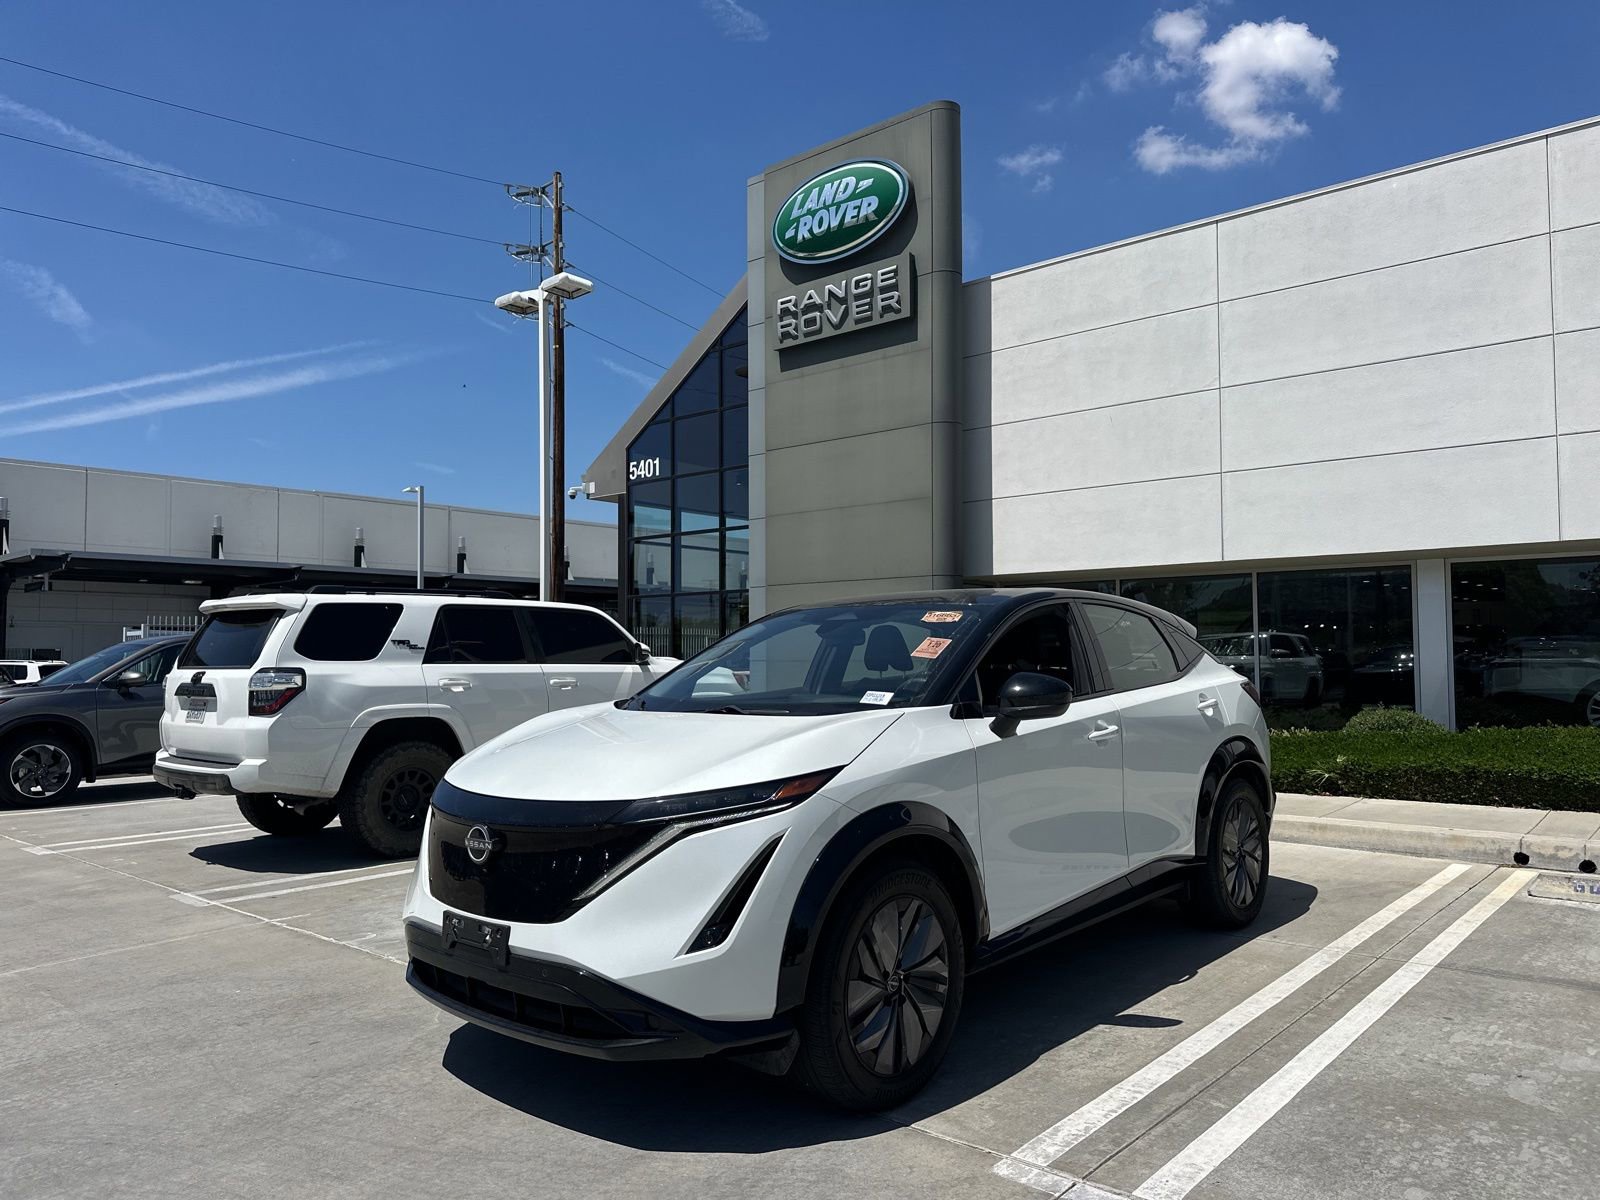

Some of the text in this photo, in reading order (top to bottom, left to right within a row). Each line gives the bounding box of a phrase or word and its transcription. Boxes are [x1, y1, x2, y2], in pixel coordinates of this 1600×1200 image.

[796, 195, 879, 244] ROVER
[777, 264, 898, 316] RANGE
[777, 291, 902, 344] ROVER
[629, 456, 660, 480] 5401
[465, 838, 492, 850] SSAN
